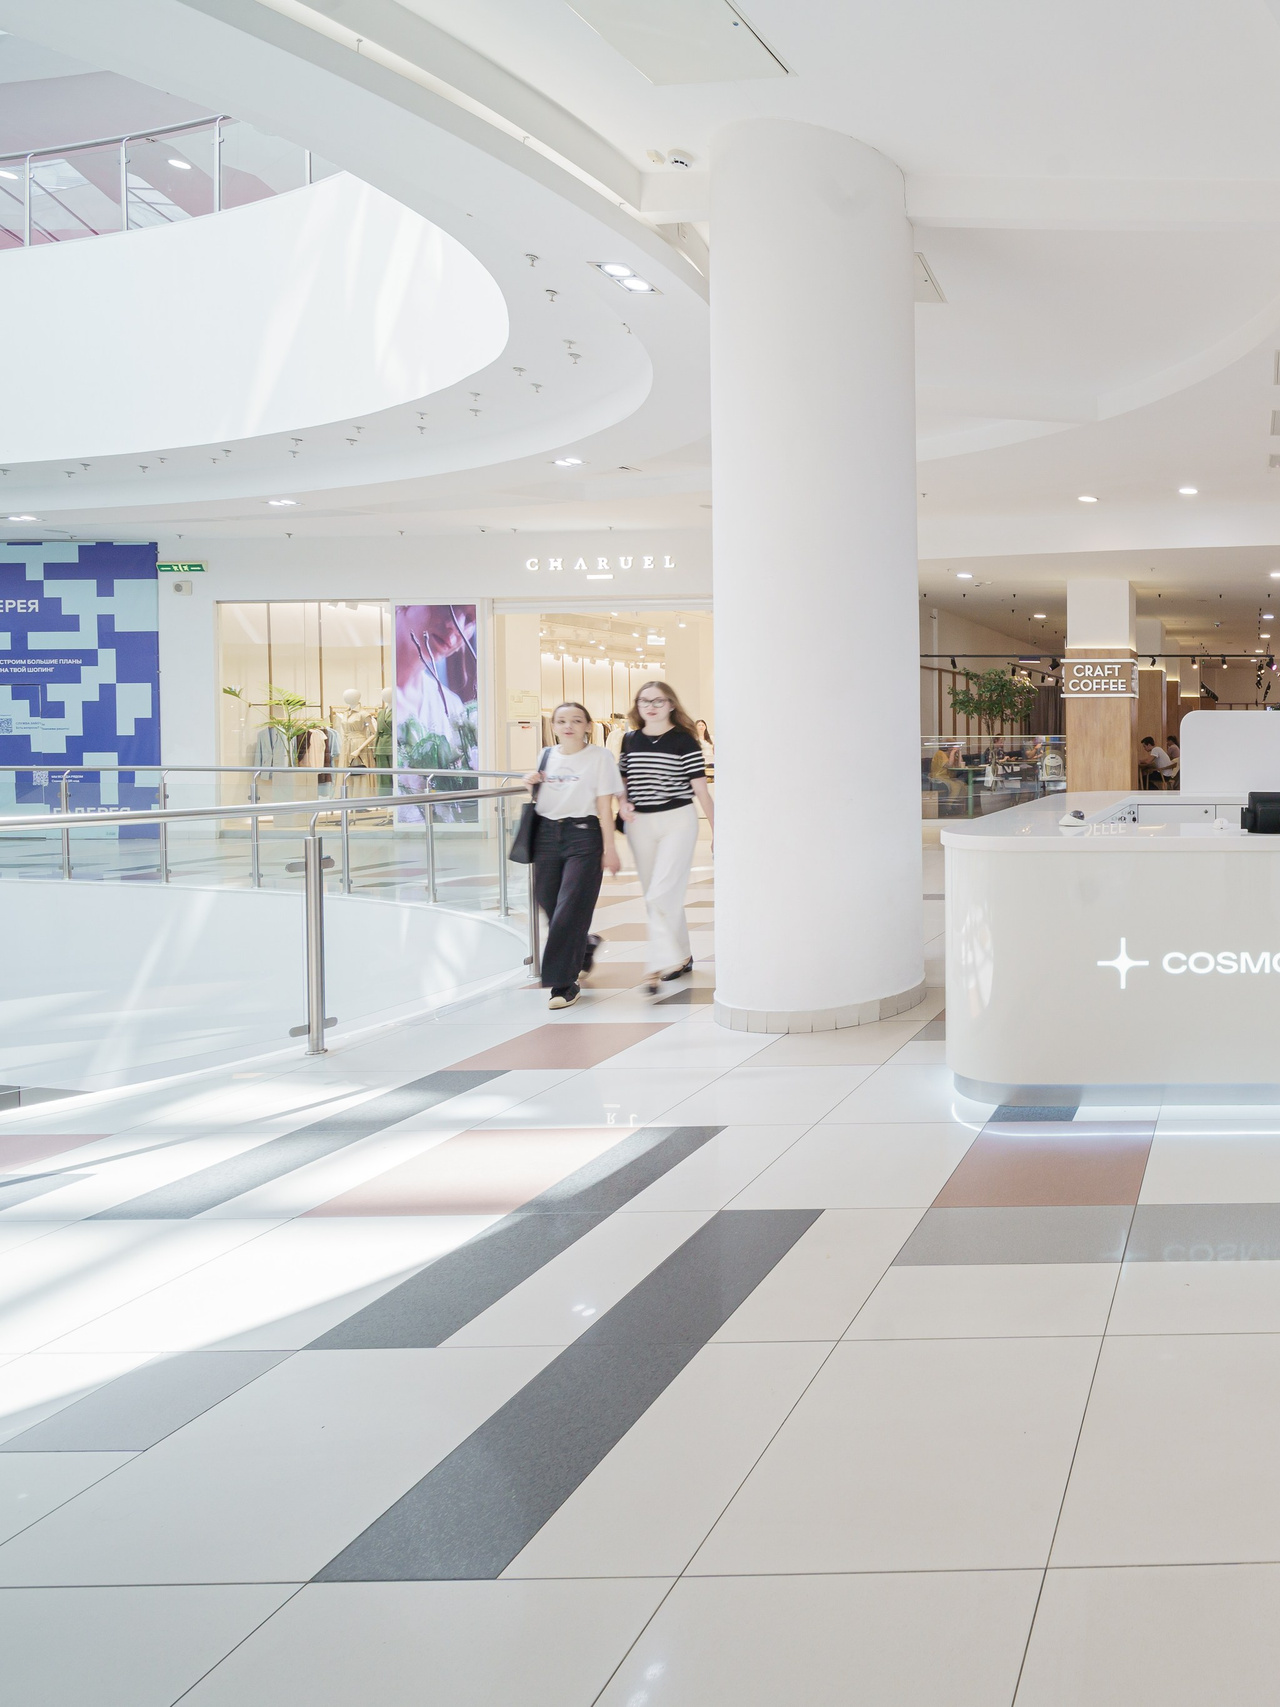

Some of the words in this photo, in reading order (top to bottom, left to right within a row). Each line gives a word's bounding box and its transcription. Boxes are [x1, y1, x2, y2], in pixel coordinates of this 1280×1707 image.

[525, 555, 675, 571] CHARUEL
[1073, 664, 1121, 677] CRAFT
[1068, 679, 1127, 692] COFFEE
